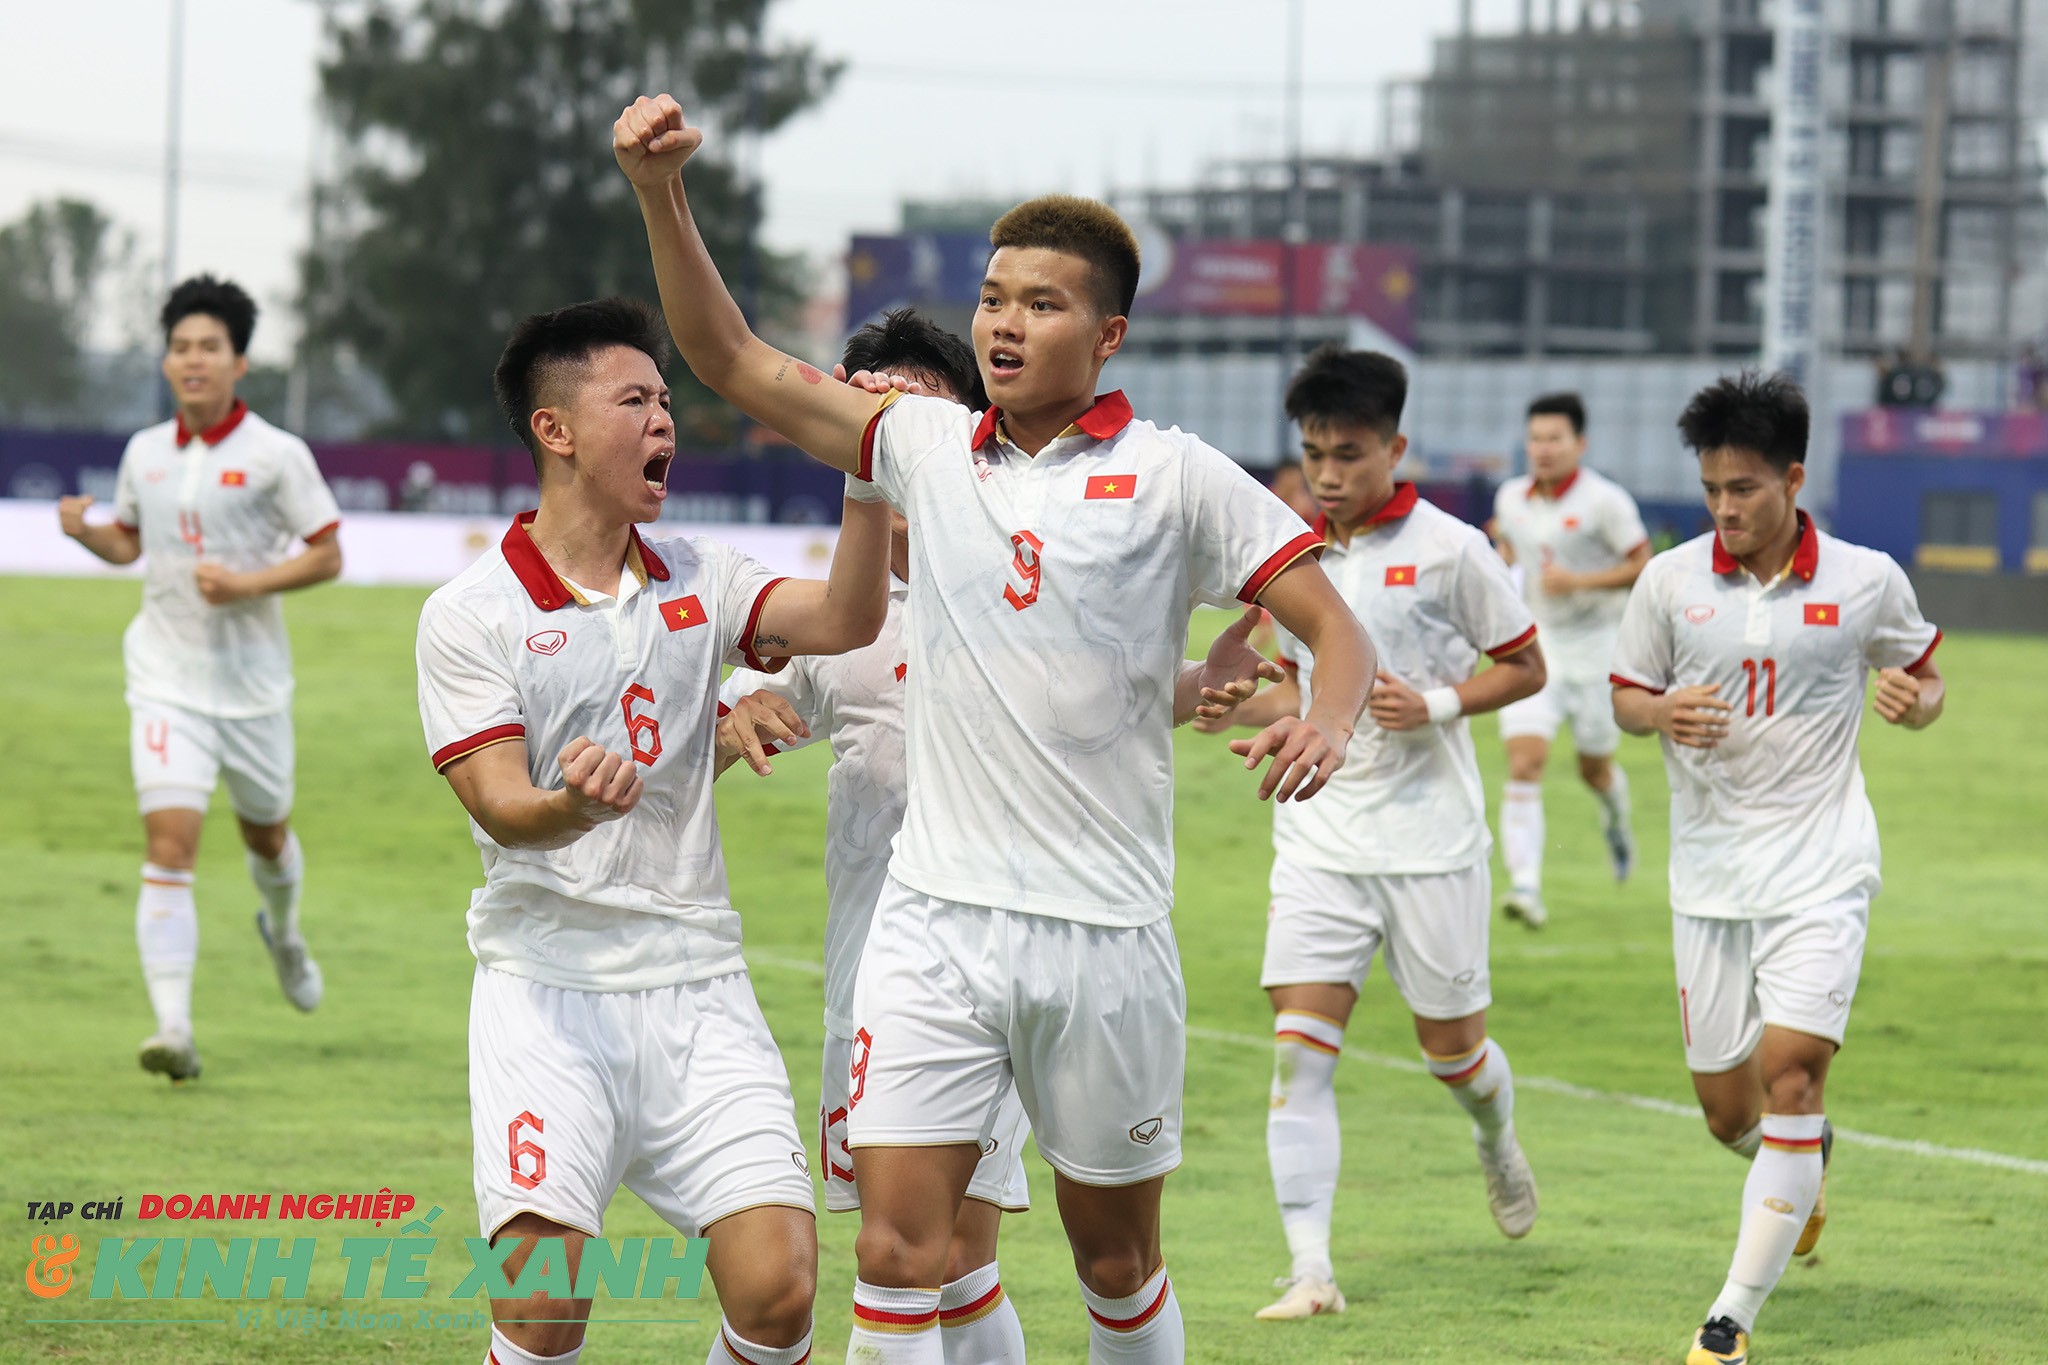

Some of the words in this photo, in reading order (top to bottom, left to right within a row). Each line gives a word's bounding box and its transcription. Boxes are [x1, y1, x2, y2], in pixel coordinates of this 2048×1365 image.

[179, 510, 203, 557] 4
[1003, 529, 1045, 612] 9
[620, 682, 663, 767] 6
[1742, 657, 1777, 717] 11
[145, 720, 169, 765] 4
[848, 1027, 873, 1111] 9
[508, 1110, 547, 1191] 6
